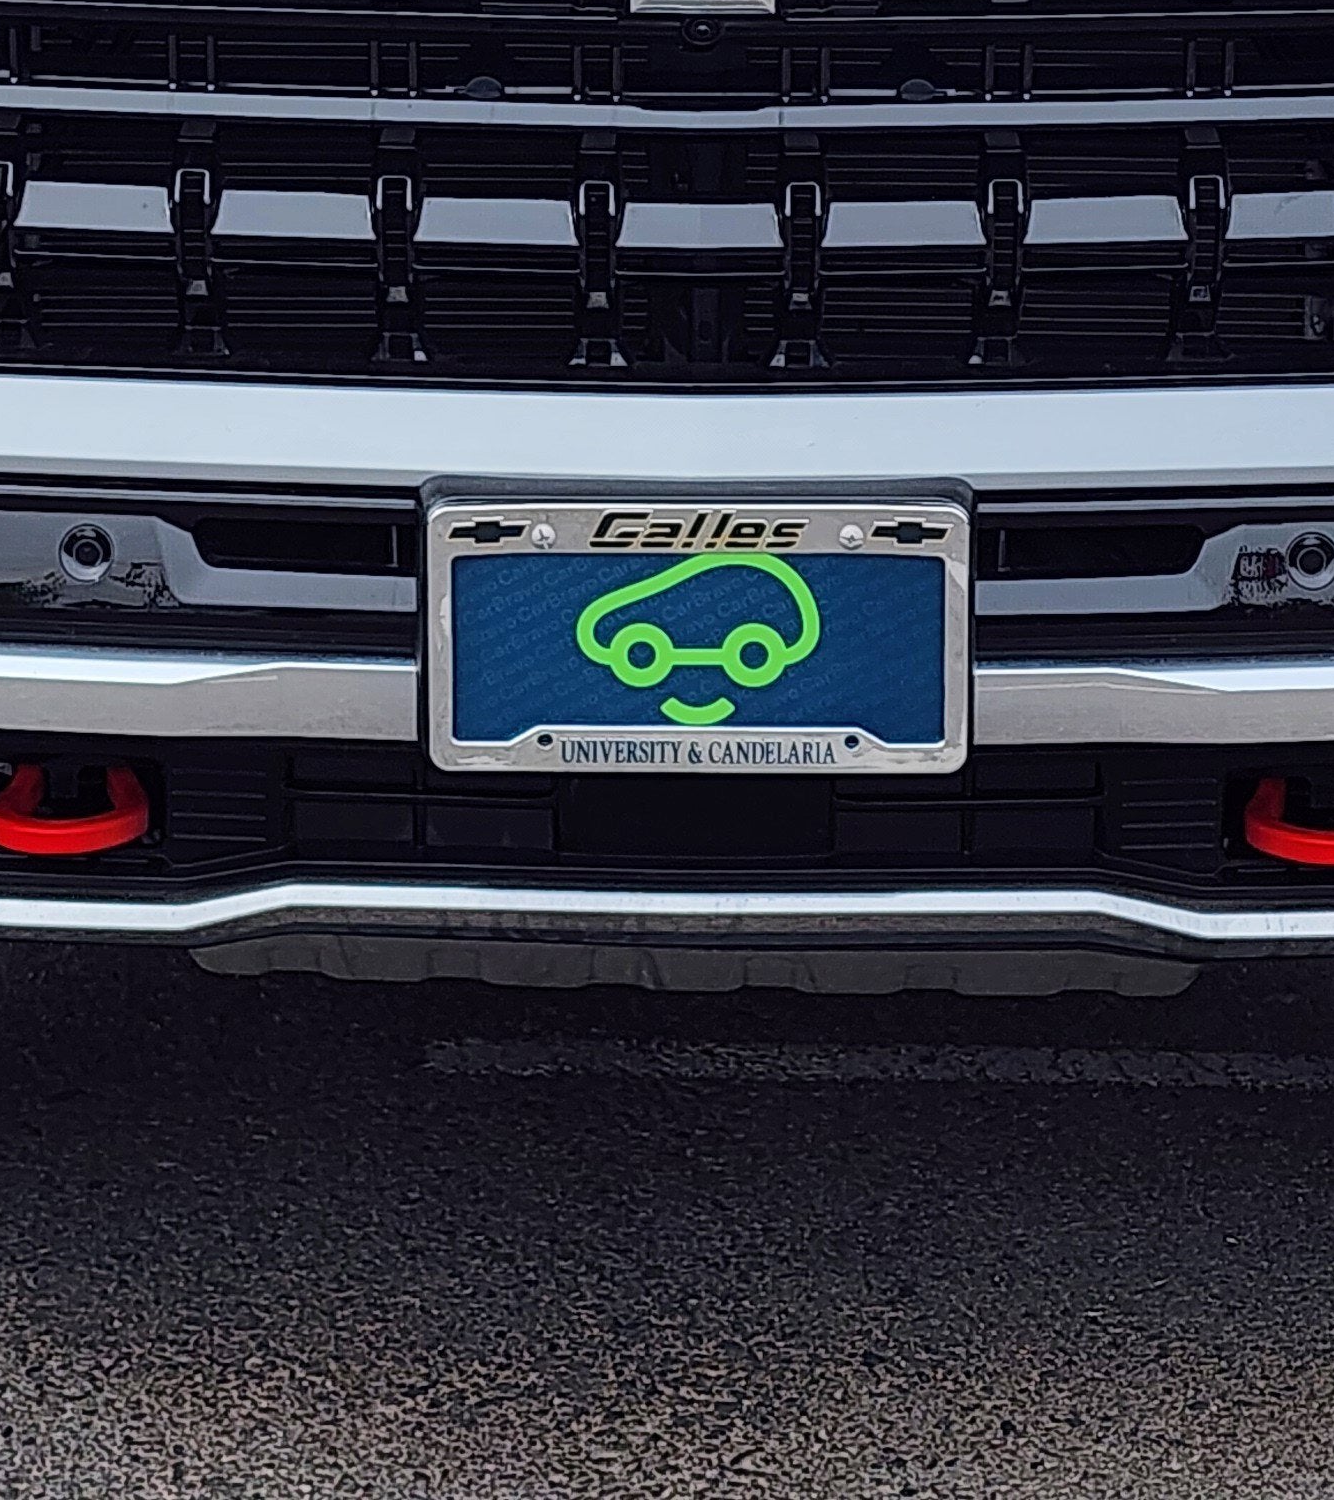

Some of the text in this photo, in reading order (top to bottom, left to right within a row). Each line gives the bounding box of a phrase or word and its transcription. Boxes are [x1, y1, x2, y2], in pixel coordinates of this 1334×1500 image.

[589, 509, 809, 549] Galles
[560, 739, 838, 766] UNIVERSITY & CANDELARIA
